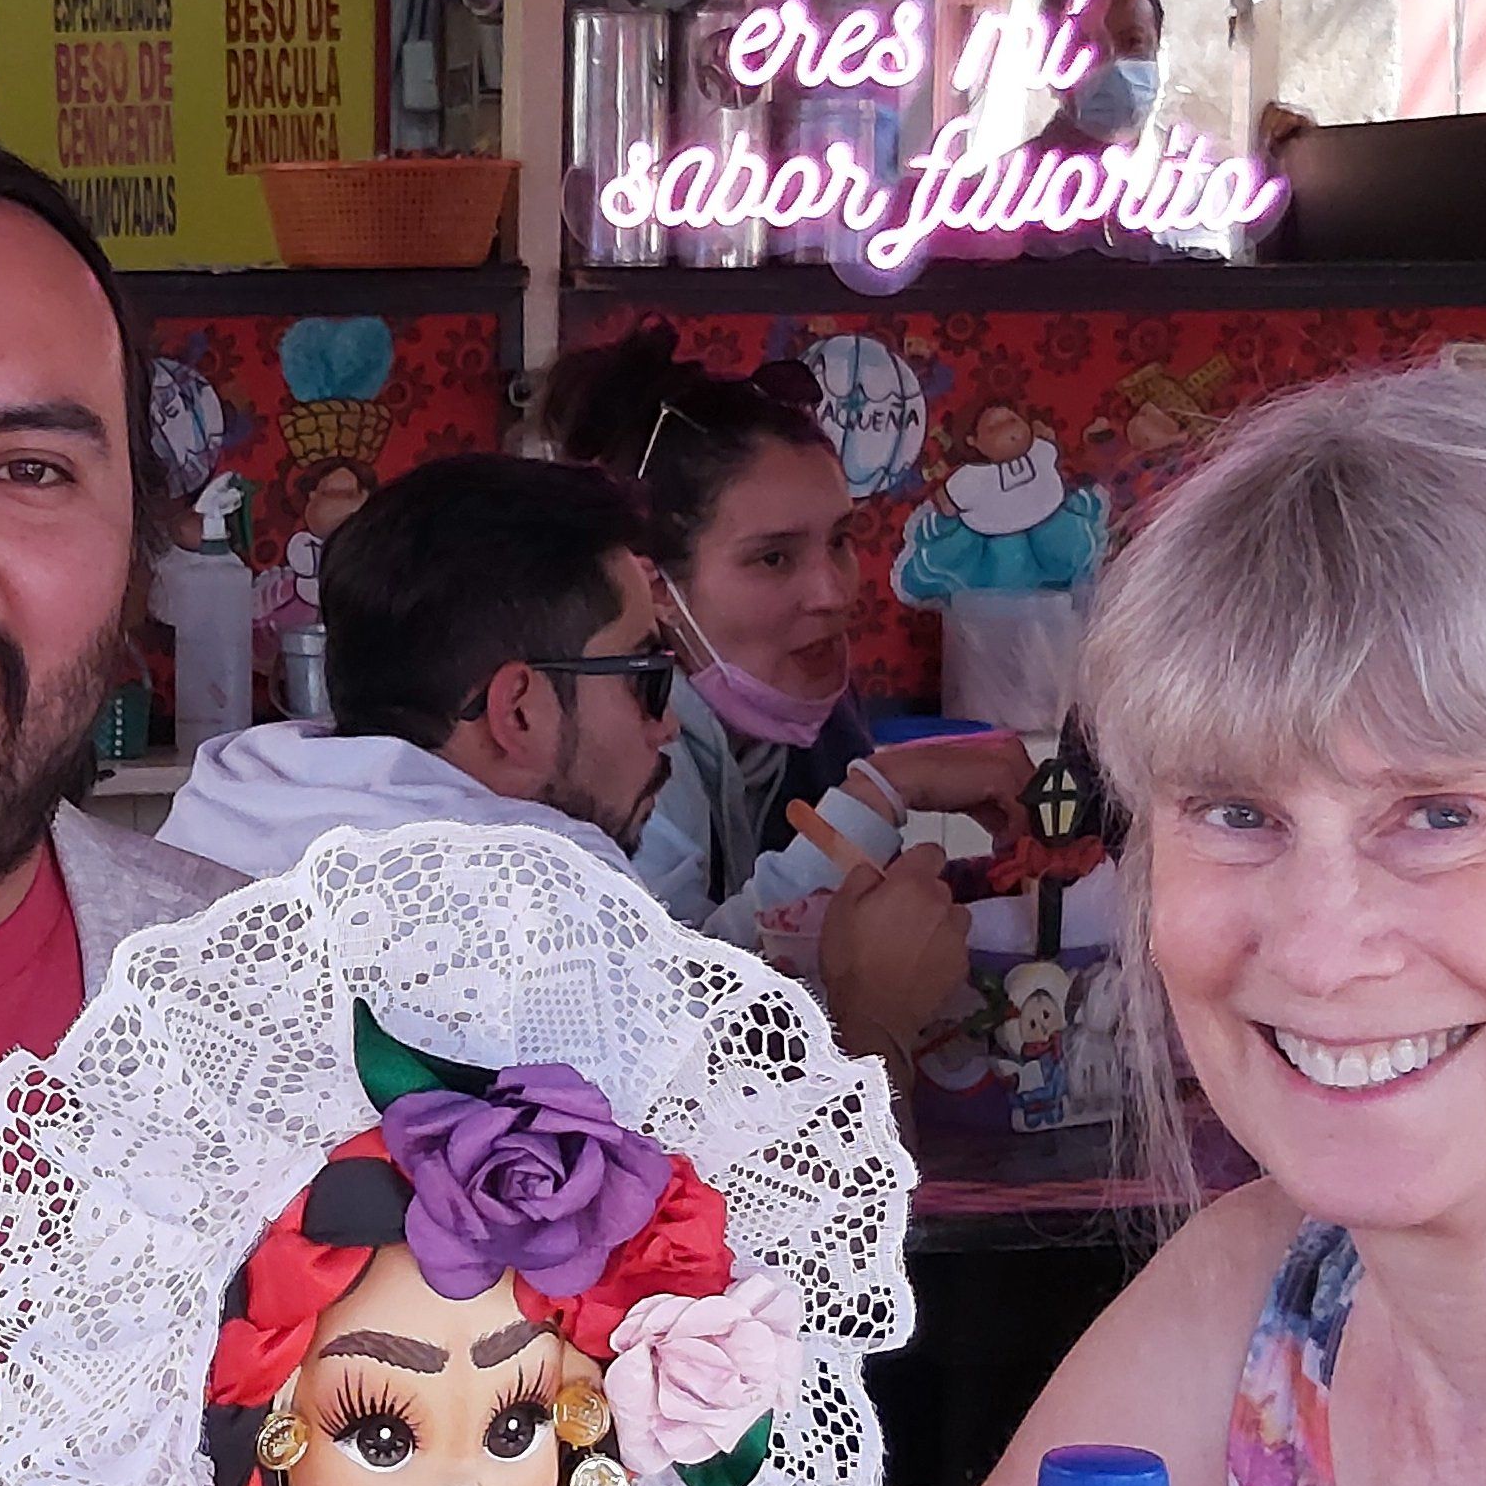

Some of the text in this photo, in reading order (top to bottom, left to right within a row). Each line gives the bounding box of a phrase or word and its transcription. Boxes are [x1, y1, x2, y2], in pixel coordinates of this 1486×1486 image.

[55, 41, 174, 104] BESO DE
[226, 47, 342, 109] DRACULA
[57, 104, 176, 168] CENICIENTA
[226, 113, 341, 175] ZANDUNGA
[599, 114, 1289, 273] sabor favorito
